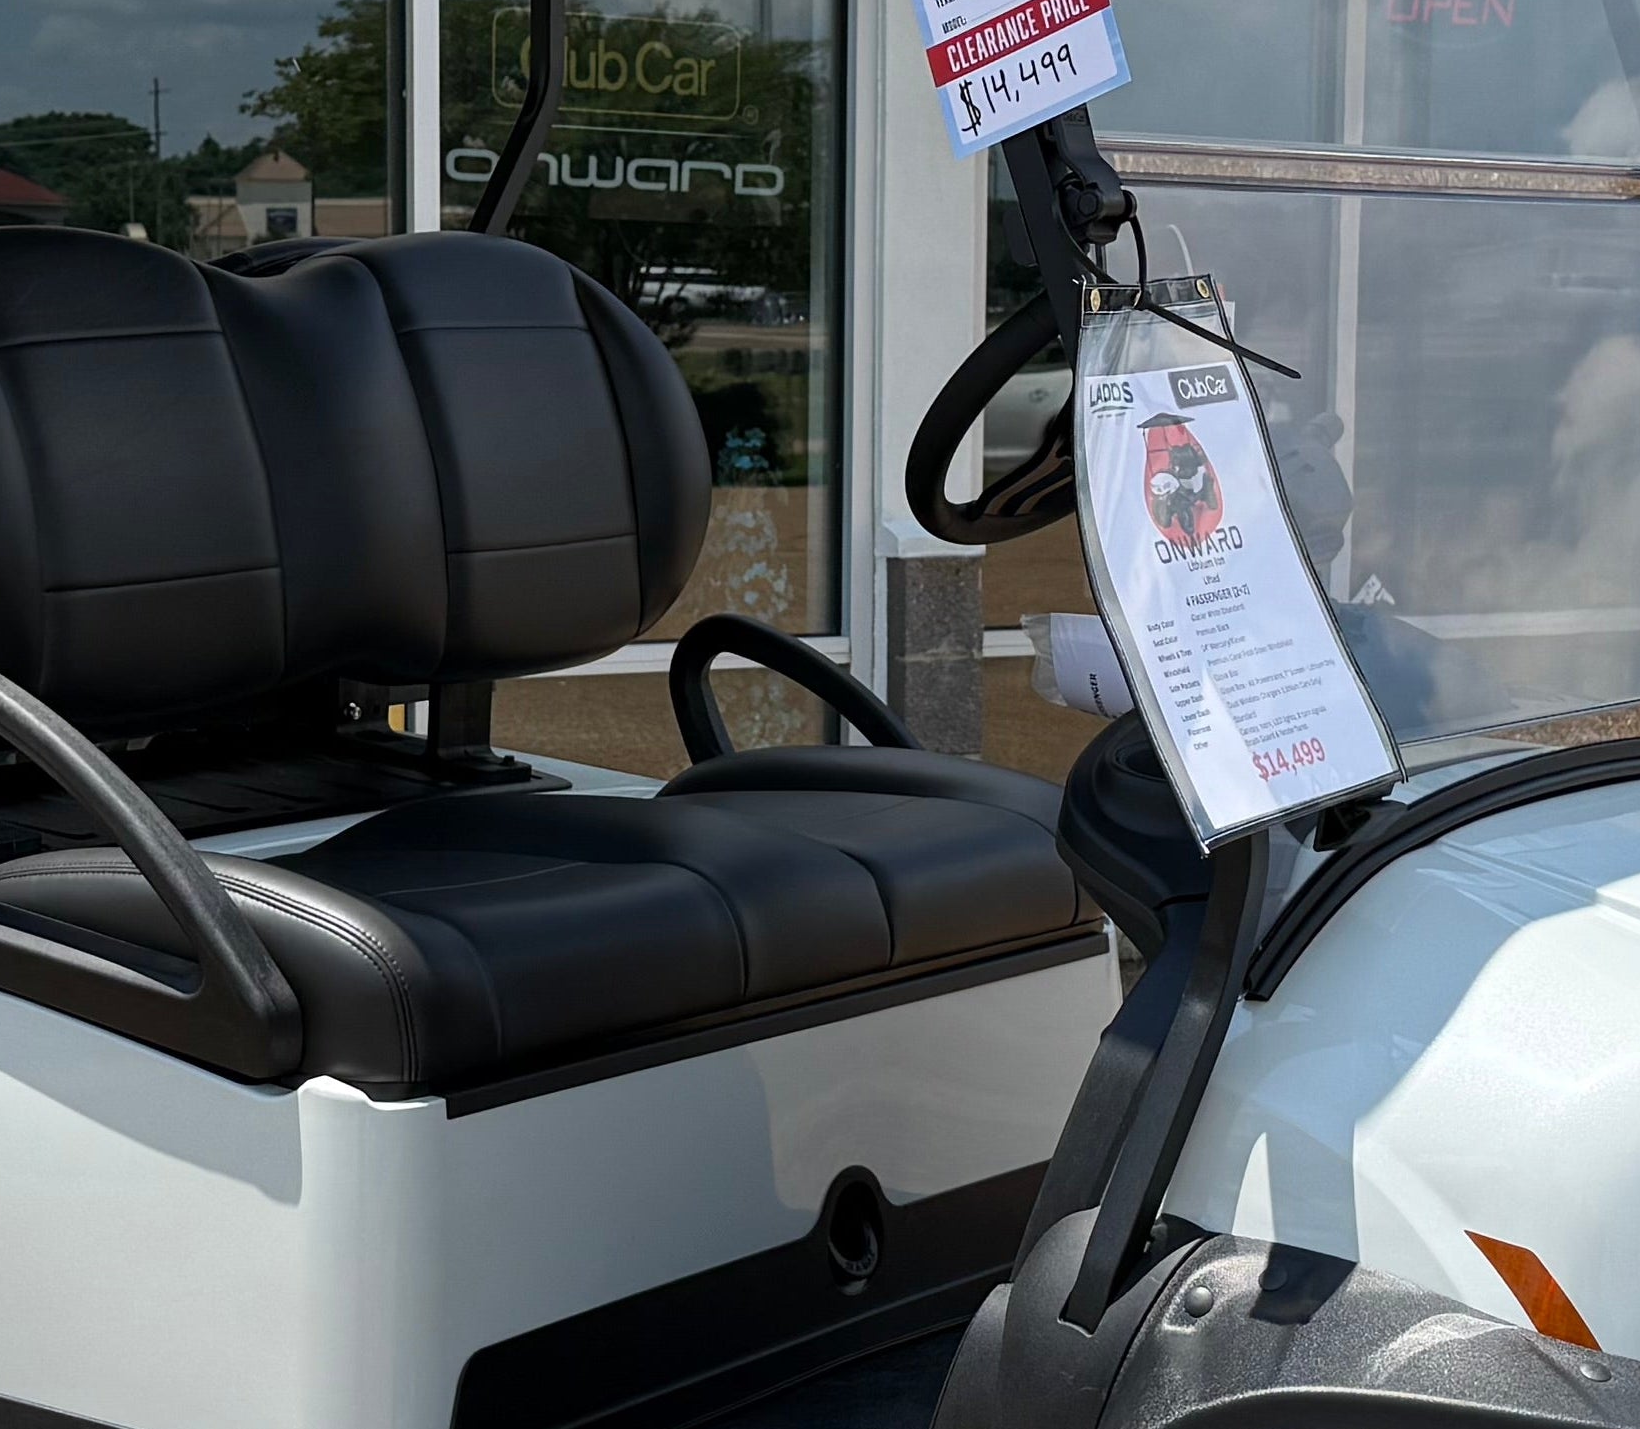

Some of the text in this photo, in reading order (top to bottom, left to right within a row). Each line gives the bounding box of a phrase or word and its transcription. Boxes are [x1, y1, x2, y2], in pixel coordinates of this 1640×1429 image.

[946, 8, 1039, 73] CLEARANCE
[635, 41, 716, 96] Car
[960, 43, 1077, 137] $14,499
[1177, 377, 1207, 400] Club
[1154, 525, 1244, 564] ONWARD
[1252, 737, 1326, 783] $14,499
